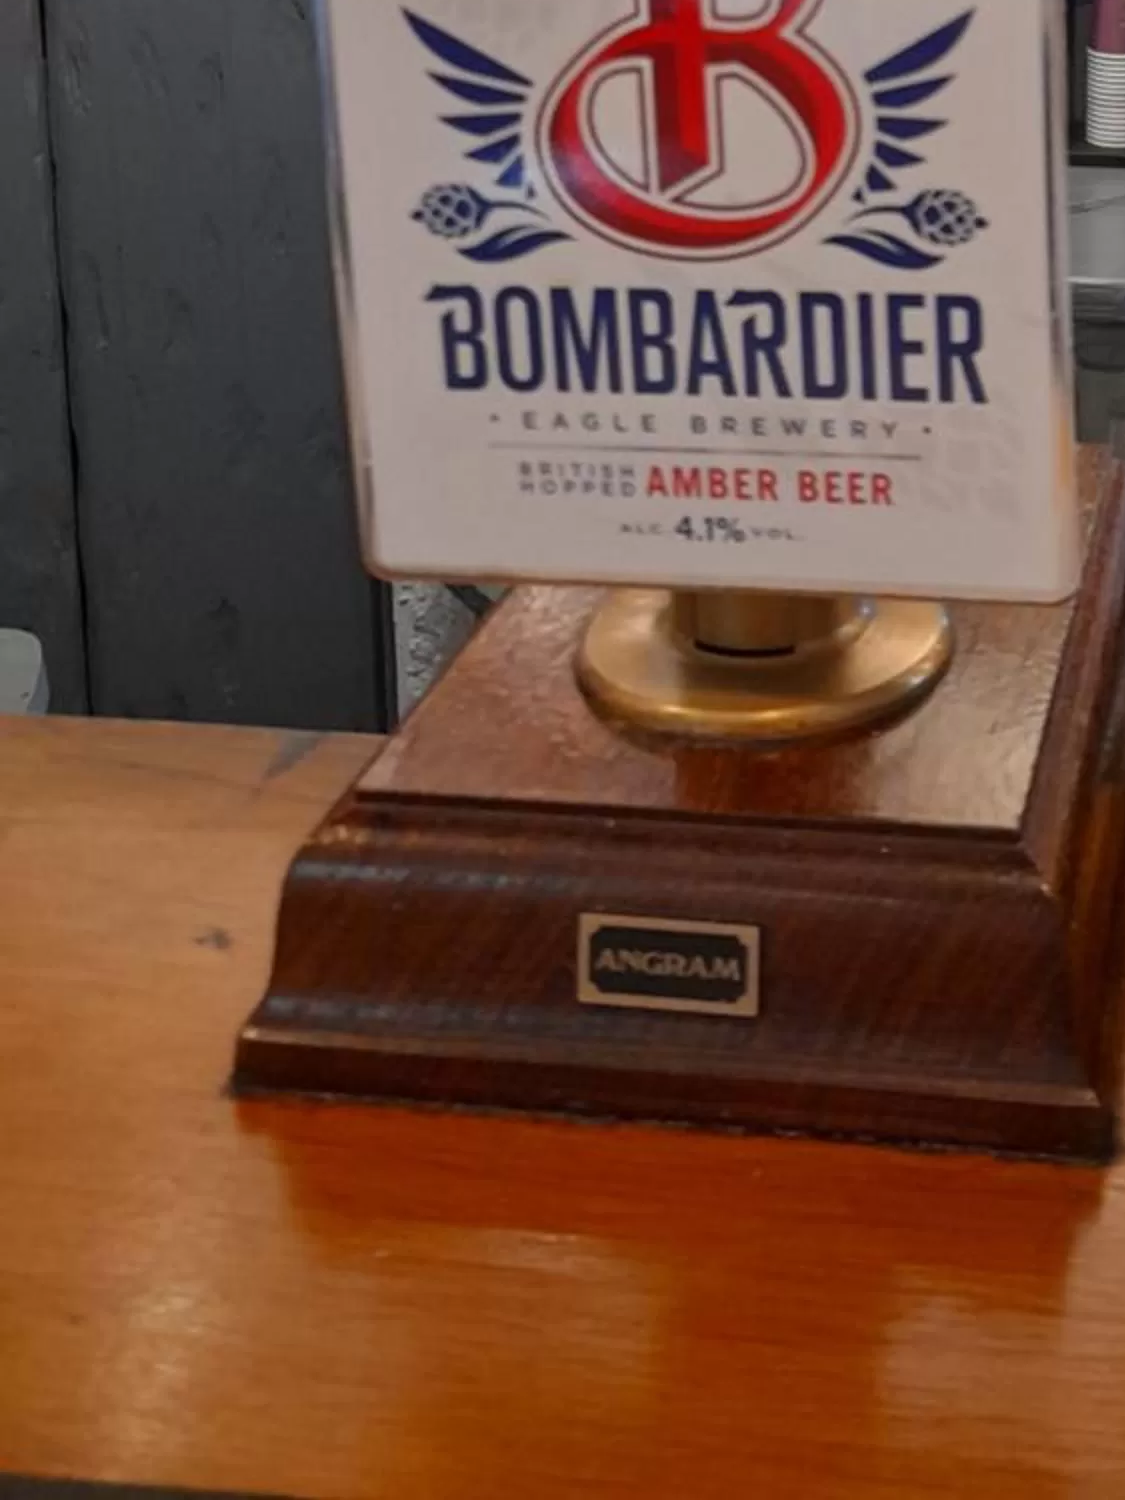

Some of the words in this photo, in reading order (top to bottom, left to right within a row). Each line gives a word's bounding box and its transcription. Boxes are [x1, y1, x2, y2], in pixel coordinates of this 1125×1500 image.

[424, 284, 988, 404] BOMBARDIER
[522, 411, 658, 433] EAGLE
[690, 415, 900, 439] BREWERY
[518, 460, 636, 479] BRITISH
[518, 479, 637, 498] HOPPED
[646, 464, 778, 501] AMBER
[797, 469, 896, 506] BEER
[674, 515, 747, 543] 4.1%
[593, 947, 742, 982] ANGRAM
